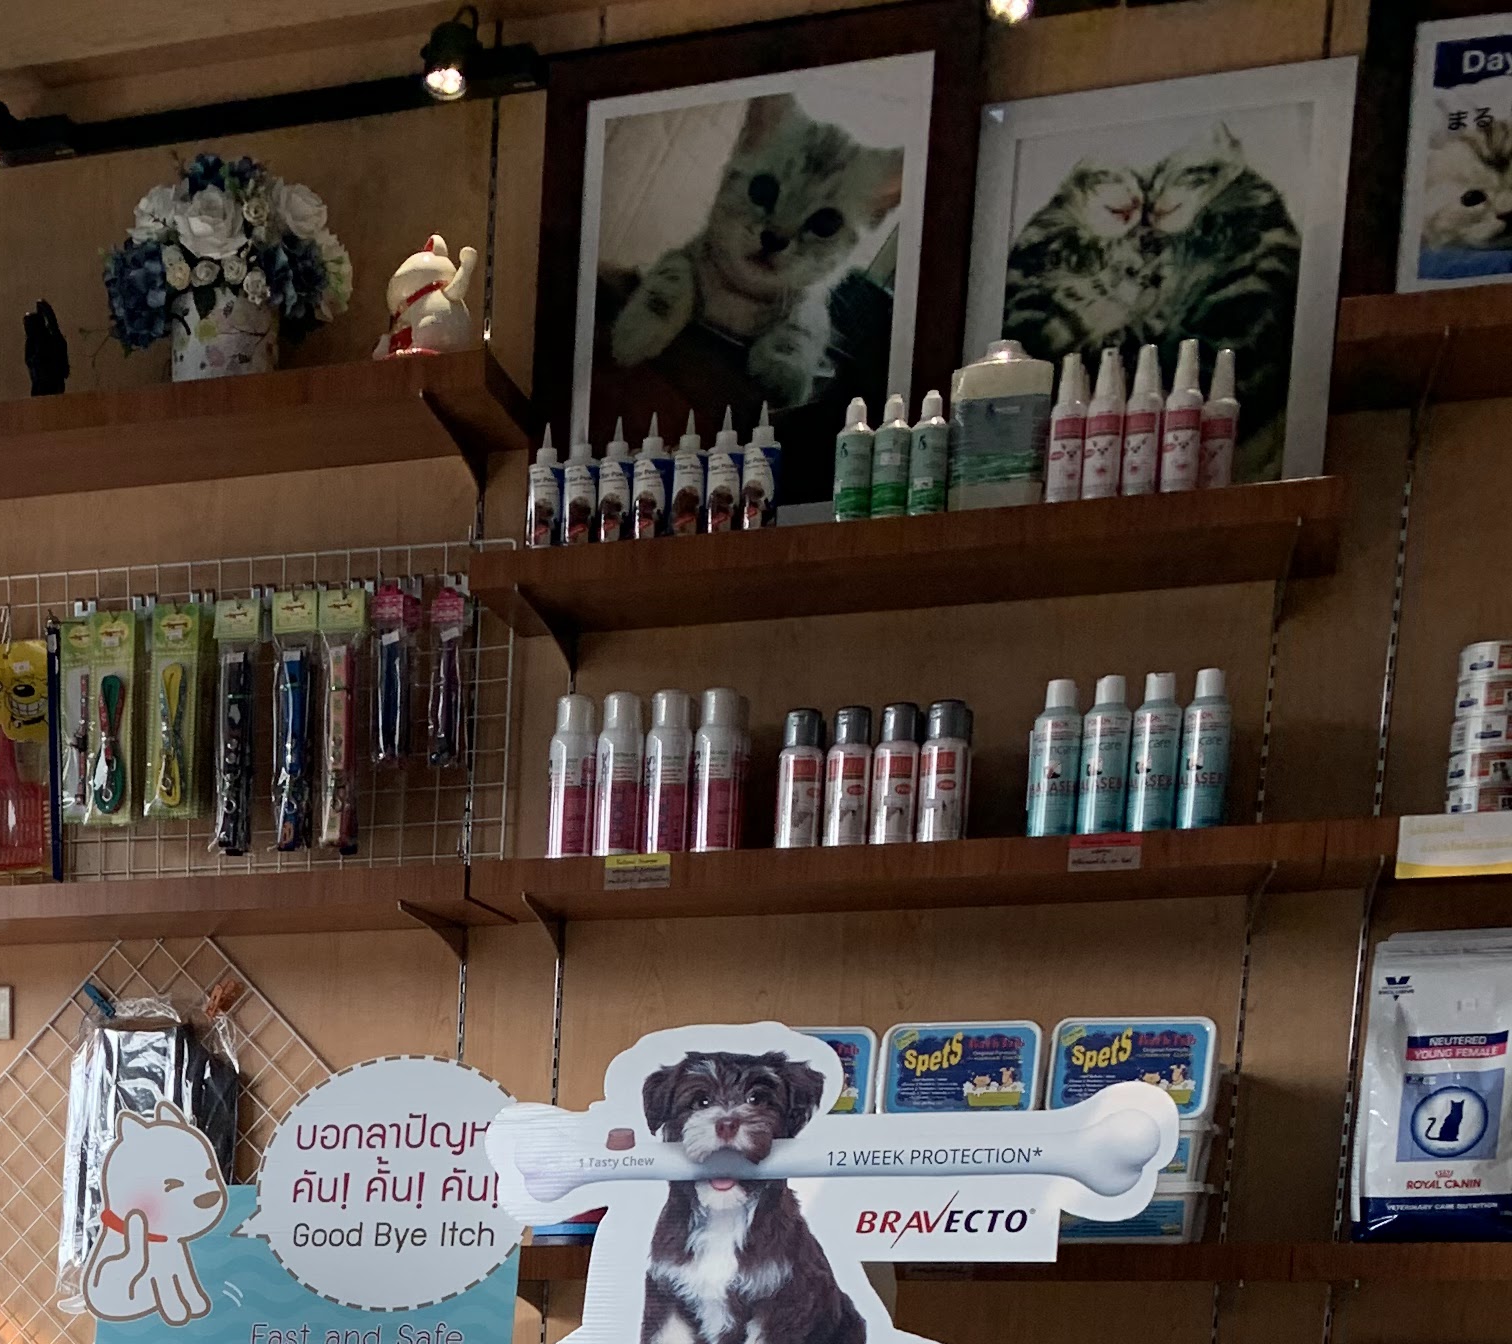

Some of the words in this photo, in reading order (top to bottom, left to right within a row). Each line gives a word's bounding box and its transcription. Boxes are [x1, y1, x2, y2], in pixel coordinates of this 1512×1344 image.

[1429, 1036, 1487, 1046] NEUTERED
[1414, 1048, 1453, 1059] YOUNG
[1456, 1047, 1498, 1057] FEMALE
[295, 1112, 492, 1150] บอกลาปัญห
[589, 1158, 619, 1170] Tasty
[622, 1156, 655, 1166] Chew
[826, 1150, 845, 1166] 12
[852, 1149, 904, 1166] WEEK
[292, 1170, 349, 1210] คัน!
[1406, 1180, 1442, 1189] ROYAL
[1445, 1179, 1481, 1189] CANIN
[293, 1221, 363, 1248] Good
[374, 1222, 427, 1254] Bye
[440, 1221, 495, 1248] Itch
